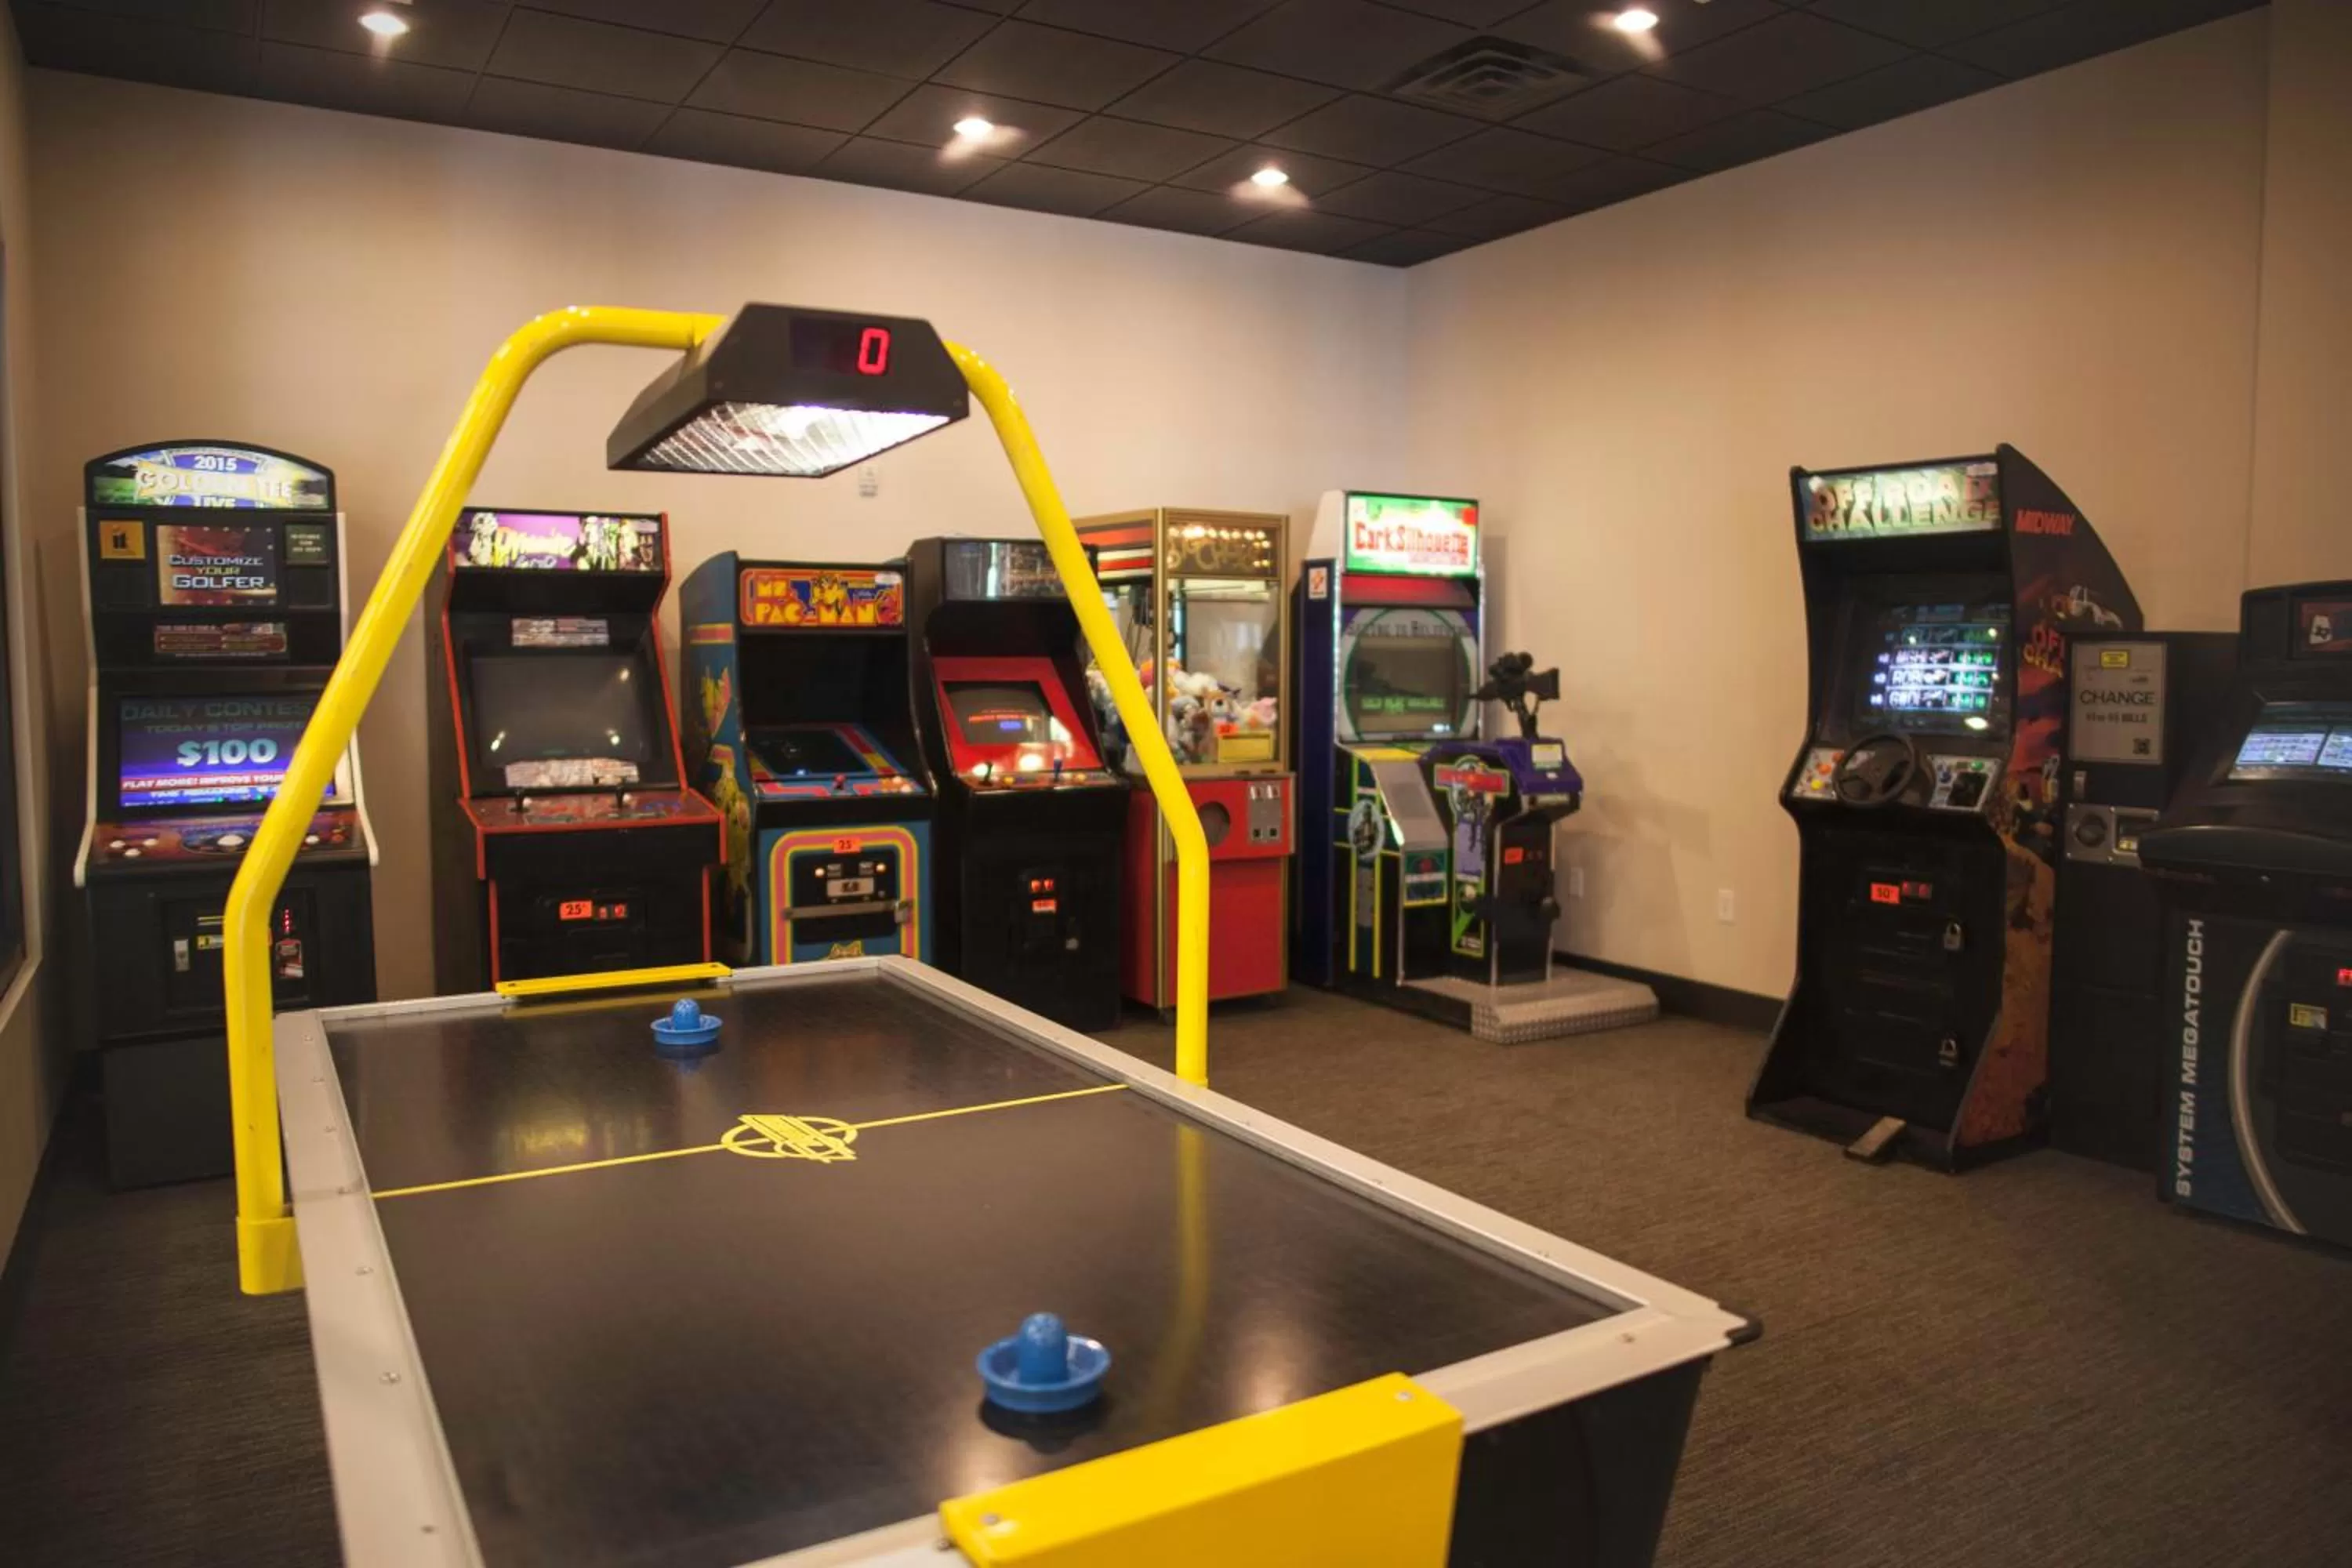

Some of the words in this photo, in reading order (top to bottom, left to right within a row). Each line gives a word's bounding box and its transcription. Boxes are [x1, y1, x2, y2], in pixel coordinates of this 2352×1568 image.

[858, 327, 890, 375] 0
[194, 455, 238, 471] 2015
[194, 495, 236, 508] LIVE
[2015, 508, 2074, 535] MIDWAY
[169, 554, 264, 565] CUSTOMIZE
[197, 566, 241, 575] YOUR
[172, 575, 265, 589] GOLFER
[2079, 690, 2155, 704] CHANGE
[122, 704, 198, 720] DAILY
[204, 702, 316, 717] CONTES
[176, 738, 278, 767] $100
[2181, 918, 2205, 1084] MEGATOUCH
[2176, 1091, 2195, 1197] SYSTEM
